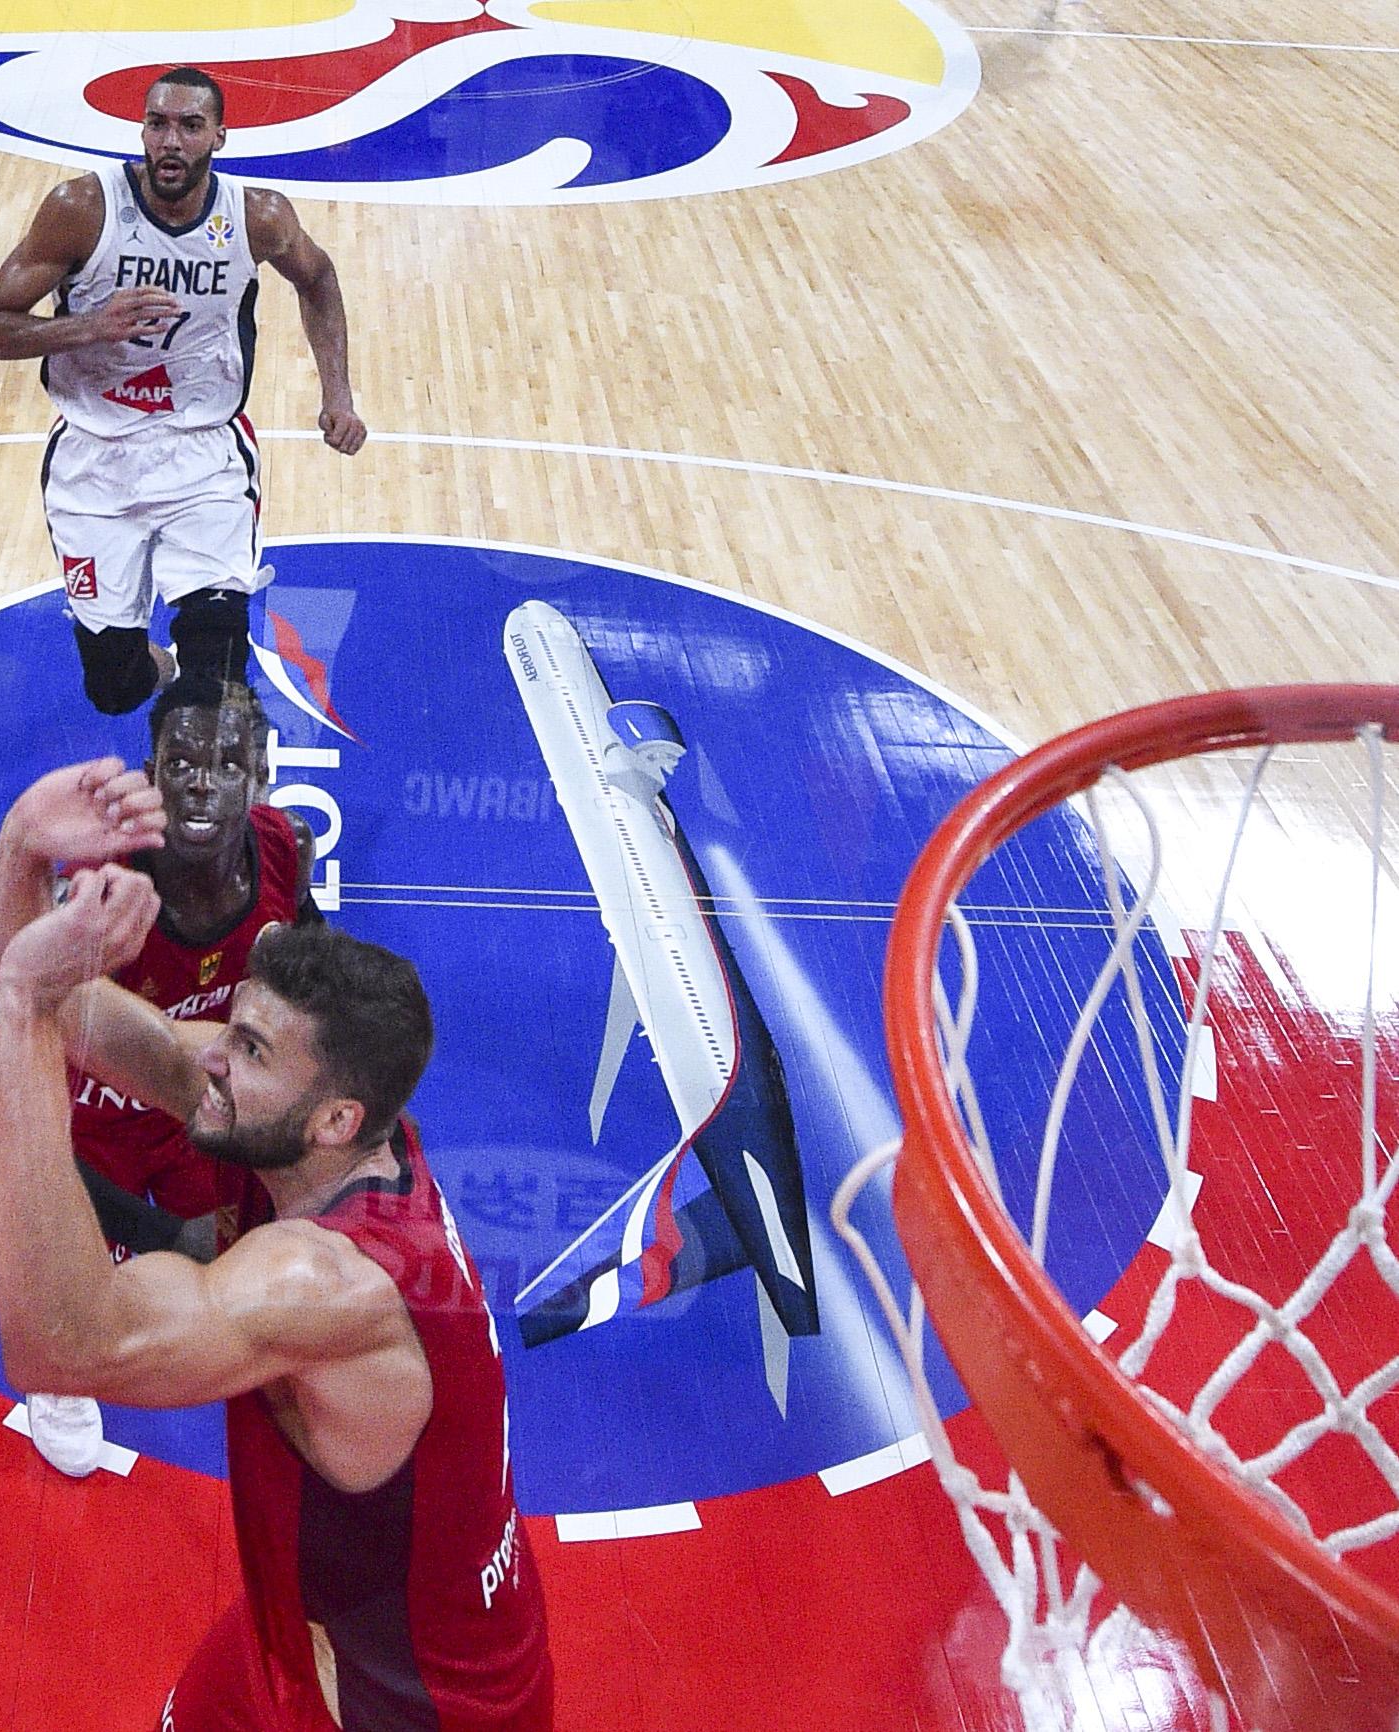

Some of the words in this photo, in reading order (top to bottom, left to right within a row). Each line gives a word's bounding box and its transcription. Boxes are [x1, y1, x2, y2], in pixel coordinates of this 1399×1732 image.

[116, 254, 230, 295] FRANCE
[115, 385, 174, 402] MAIF
[509, 633, 541, 682] AEROFLOT
